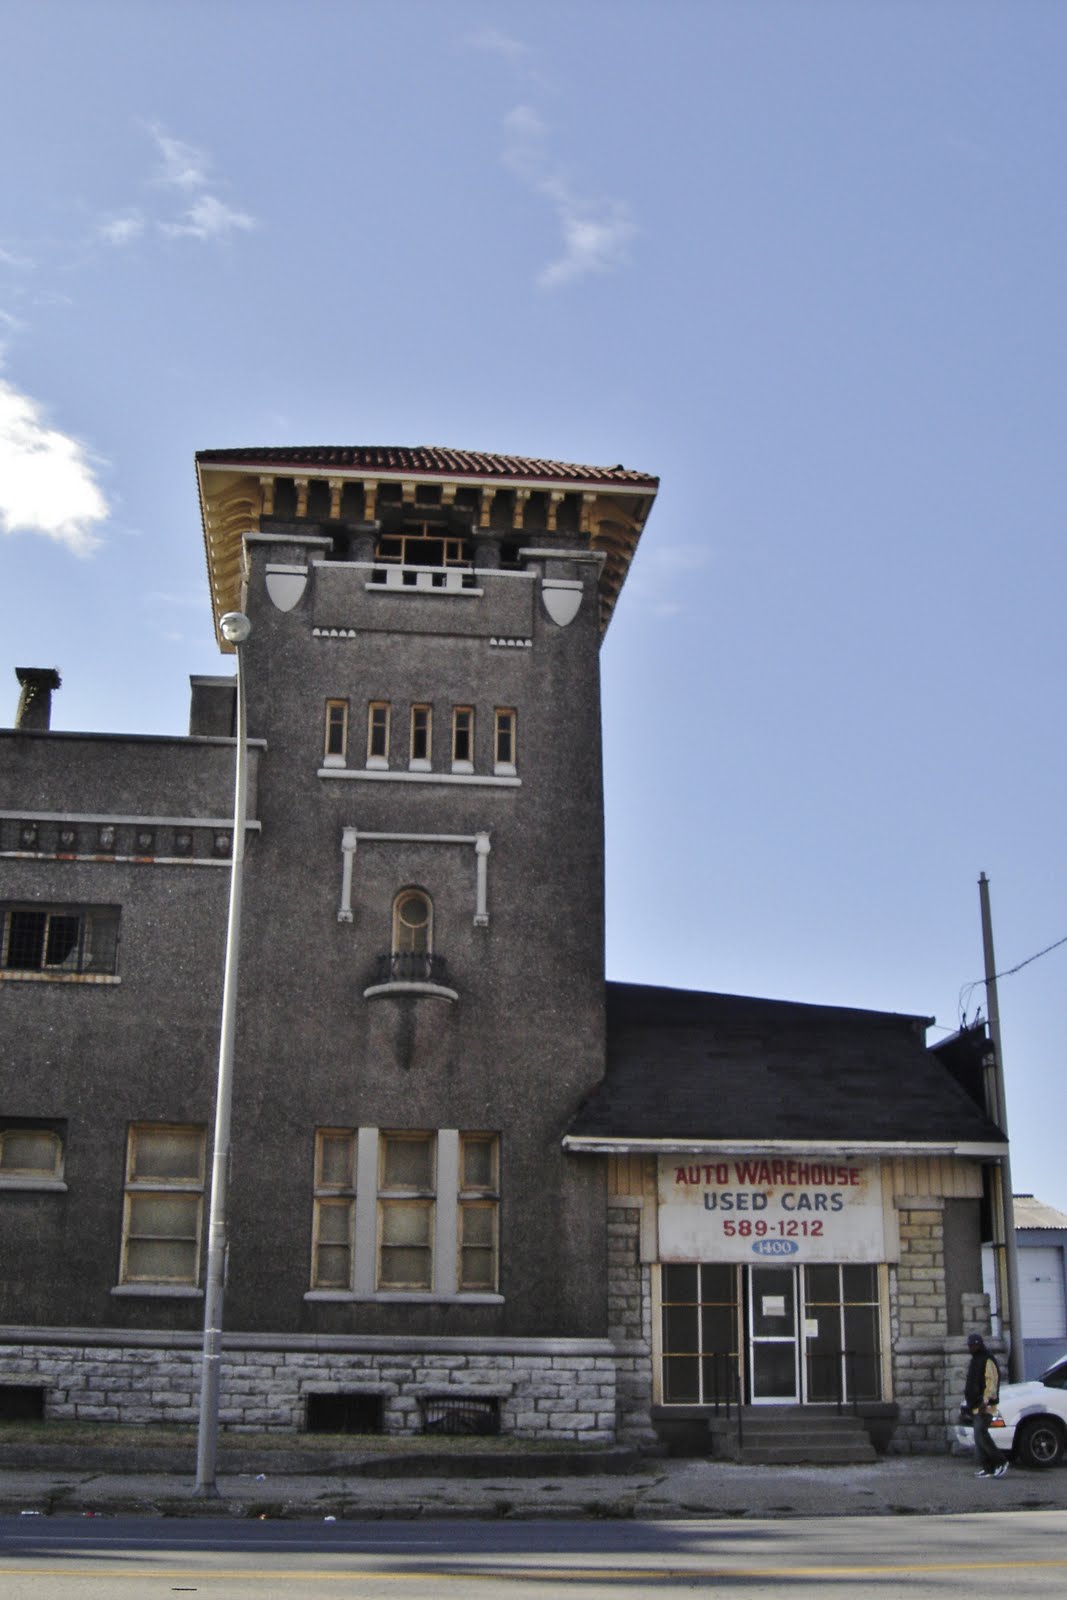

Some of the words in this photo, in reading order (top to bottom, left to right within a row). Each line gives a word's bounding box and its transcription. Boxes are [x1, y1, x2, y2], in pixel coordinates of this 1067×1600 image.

[674, 1163, 729, 1185] AUTO
[735, 1159, 861, 1186] WAREHOUSE
[704, 1193, 768, 1211] USED
[781, 1193, 844, 1212] CARS
[723, 1220, 823, 1237] 589-1212
[758, 1242, 792, 1253] 1400
